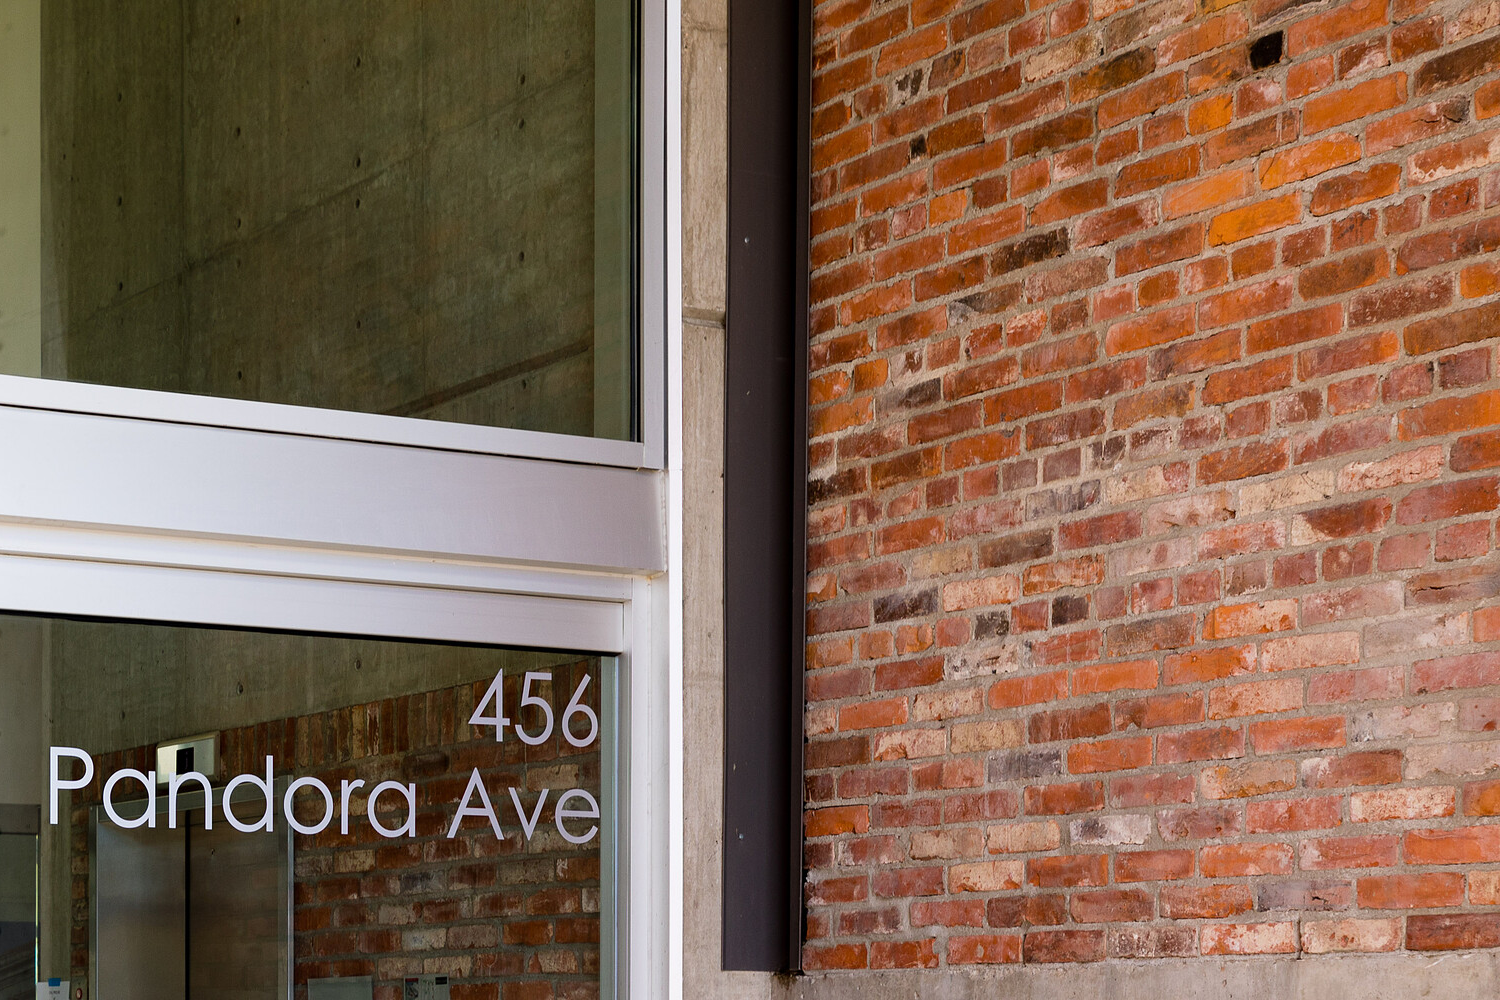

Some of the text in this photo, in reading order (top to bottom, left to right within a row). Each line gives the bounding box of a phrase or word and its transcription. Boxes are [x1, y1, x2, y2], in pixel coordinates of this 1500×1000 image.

[468, 668, 599, 748] 456
[48, 745, 600, 844] Pandora Ave
